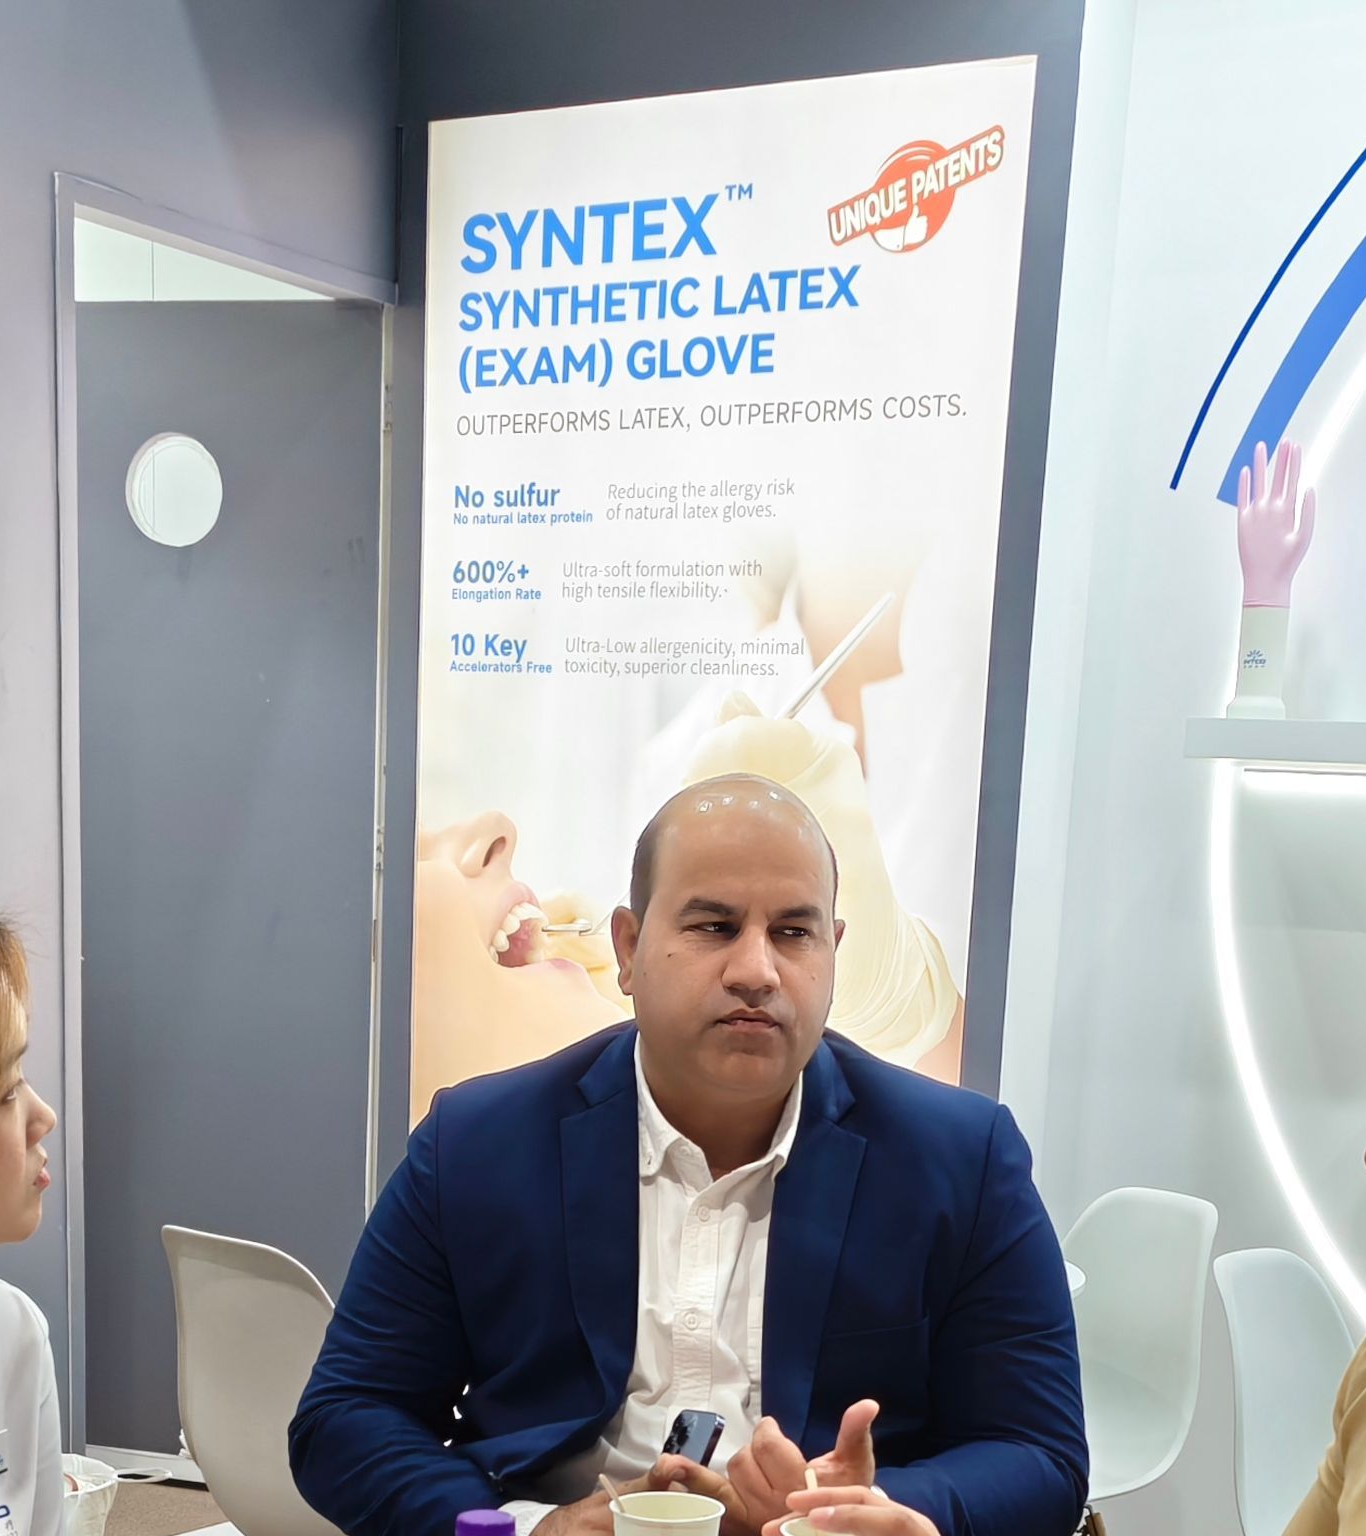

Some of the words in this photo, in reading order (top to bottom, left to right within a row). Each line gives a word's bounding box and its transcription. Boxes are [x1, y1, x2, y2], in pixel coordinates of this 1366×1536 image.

[830, 180, 909, 240] UNIQUE
[911, 131, 1004, 201] PATENTS
[459, 278, 700, 332] SYNTHETIC
[713, 265, 861, 315] LATEX
[458, 339, 612, 393] (EXAM)
[626, 333, 776, 380] GLOVE
[456, 410, 611, 437] OUTPERFORMS
[619, 405, 692, 432] LATEX,
[699, 398, 873, 427] OUTPERFORMS
[882, 394, 968, 419] COSTS.
[454, 485, 484, 508] No
[493, 482, 560, 507] sulfur
[608, 482, 677, 503] Reducing
[681, 482, 705, 498] the
[710, 480, 762, 501] allergy
[767, 479, 795, 495] risk
[453, 512, 469, 524] No
[473, 512, 513, 523] natural
[517, 511, 546, 523] latex
[550, 510, 593, 525] protein
[606, 505, 620, 520] of
[623, 503, 679, 519] natural
[683, 503, 719, 519] latex
[723, 502, 776, 522] gloves.
[452, 561, 530, 583] 600%+
[563, 561, 632, 580] Ultra-soft
[636, 561, 724, 578] formulation
[729, 560, 763, 577] with
[451, 588, 511, 603] Elongation
[515, 588, 542, 600] Rate
[561, 583, 594, 602] high
[597, 582, 646, 599] tensile
[451, 634, 477, 656] 10
[485, 634, 527, 661] Key
[564, 637, 636, 654] Ultra-Low
[640, 636, 736, 657] allergenicity,
[740, 636, 805, 655] minimal
[449, 661, 523, 673] Accelerators
[526, 661, 552, 673] Free
[564, 659, 620, 678] toxicity,
[624, 658, 686, 677] superior
[690, 658, 779, 676] cleanliness.
